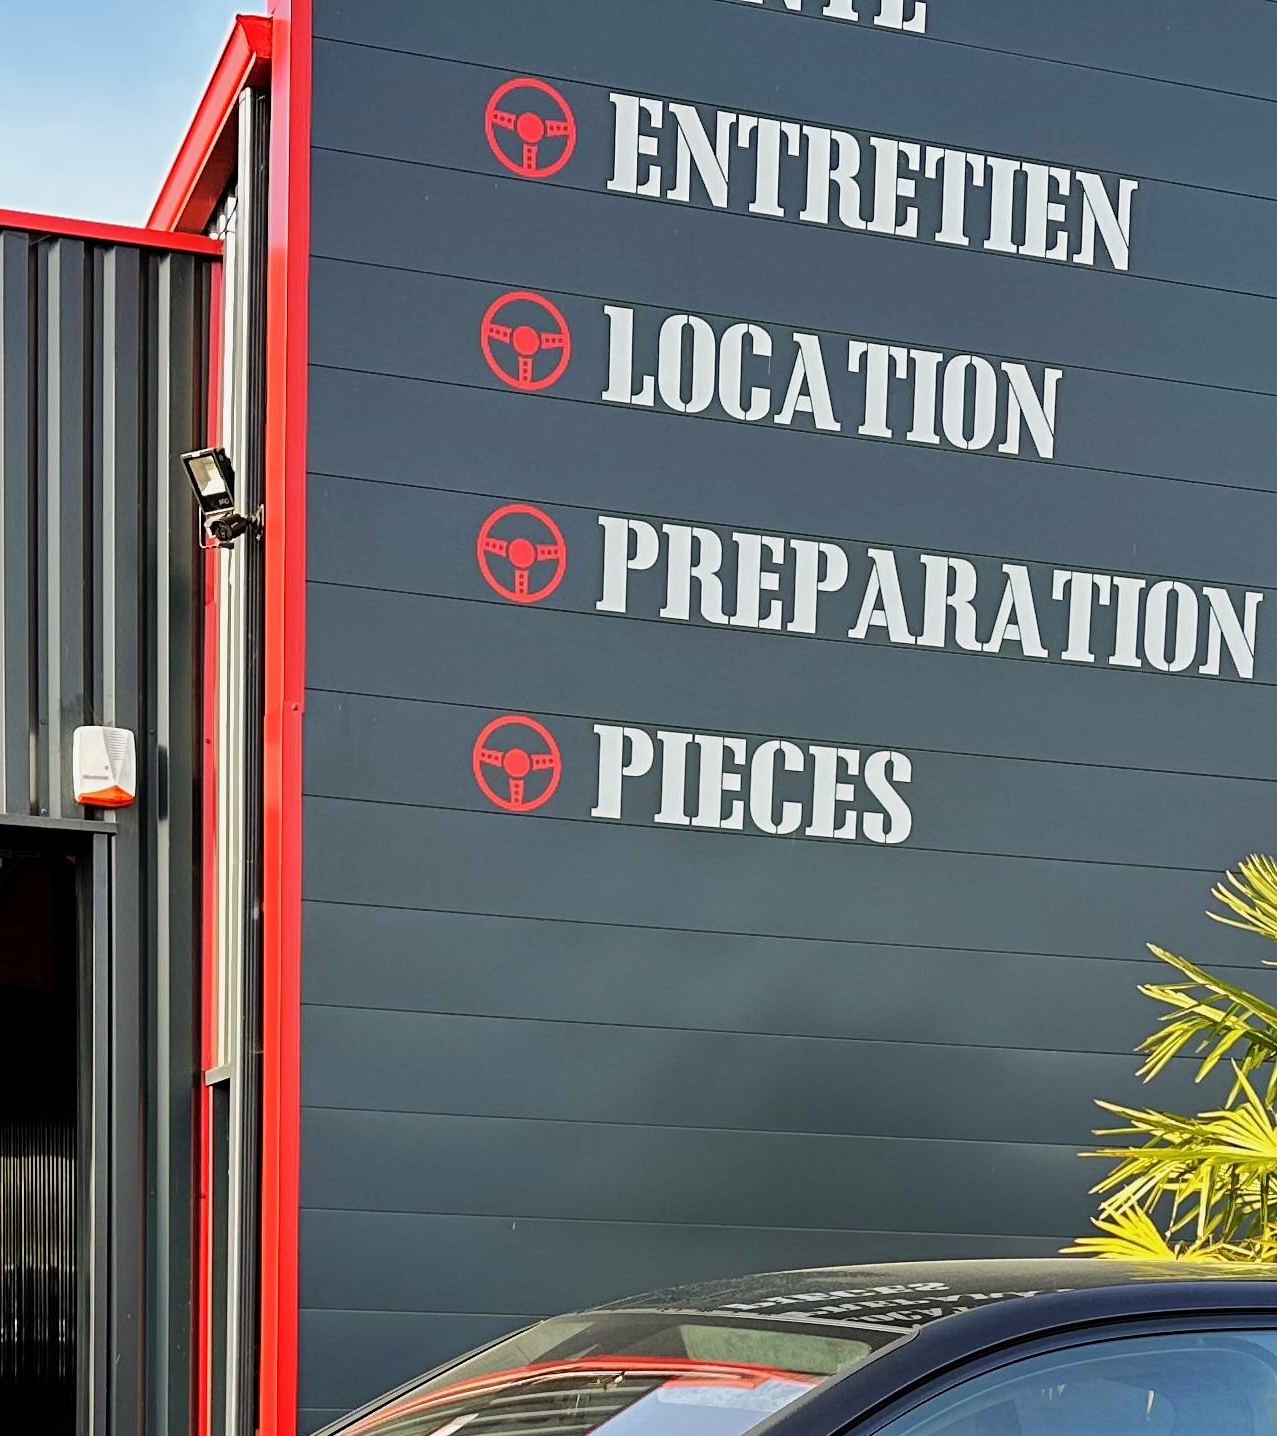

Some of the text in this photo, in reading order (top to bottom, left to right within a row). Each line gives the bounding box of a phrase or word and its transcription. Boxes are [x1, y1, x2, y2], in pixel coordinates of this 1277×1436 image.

[606, 92, 1138, 271] ENTRETIEN
[601, 305, 1063, 460] LOCATION
[595, 514, 1264, 680] PREPARATION
[590, 723, 914, 845] PIECES
